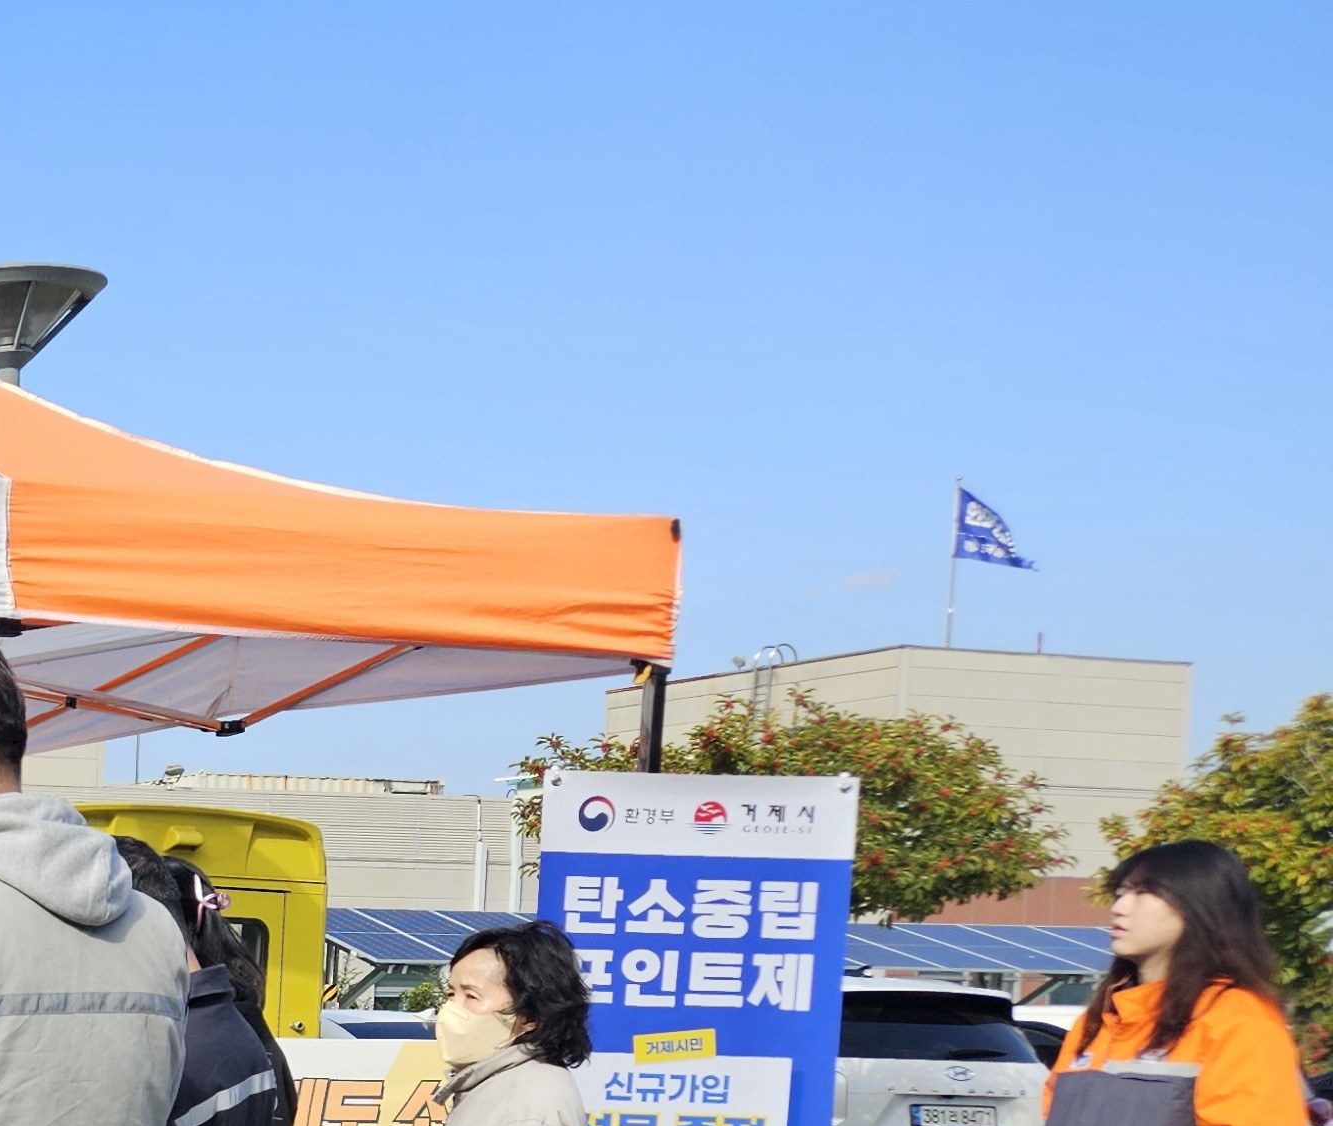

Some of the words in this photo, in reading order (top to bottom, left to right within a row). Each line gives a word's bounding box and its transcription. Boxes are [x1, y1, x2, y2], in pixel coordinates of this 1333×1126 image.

[624, 807, 675, 825] 환경부
[563, 875, 820, 940] 탄소중립
[573, 949, 815, 1012] 포인트제
[645, 1037, 703, 1055] 거제시민
[604, 1072, 731, 1104] 신규가입
